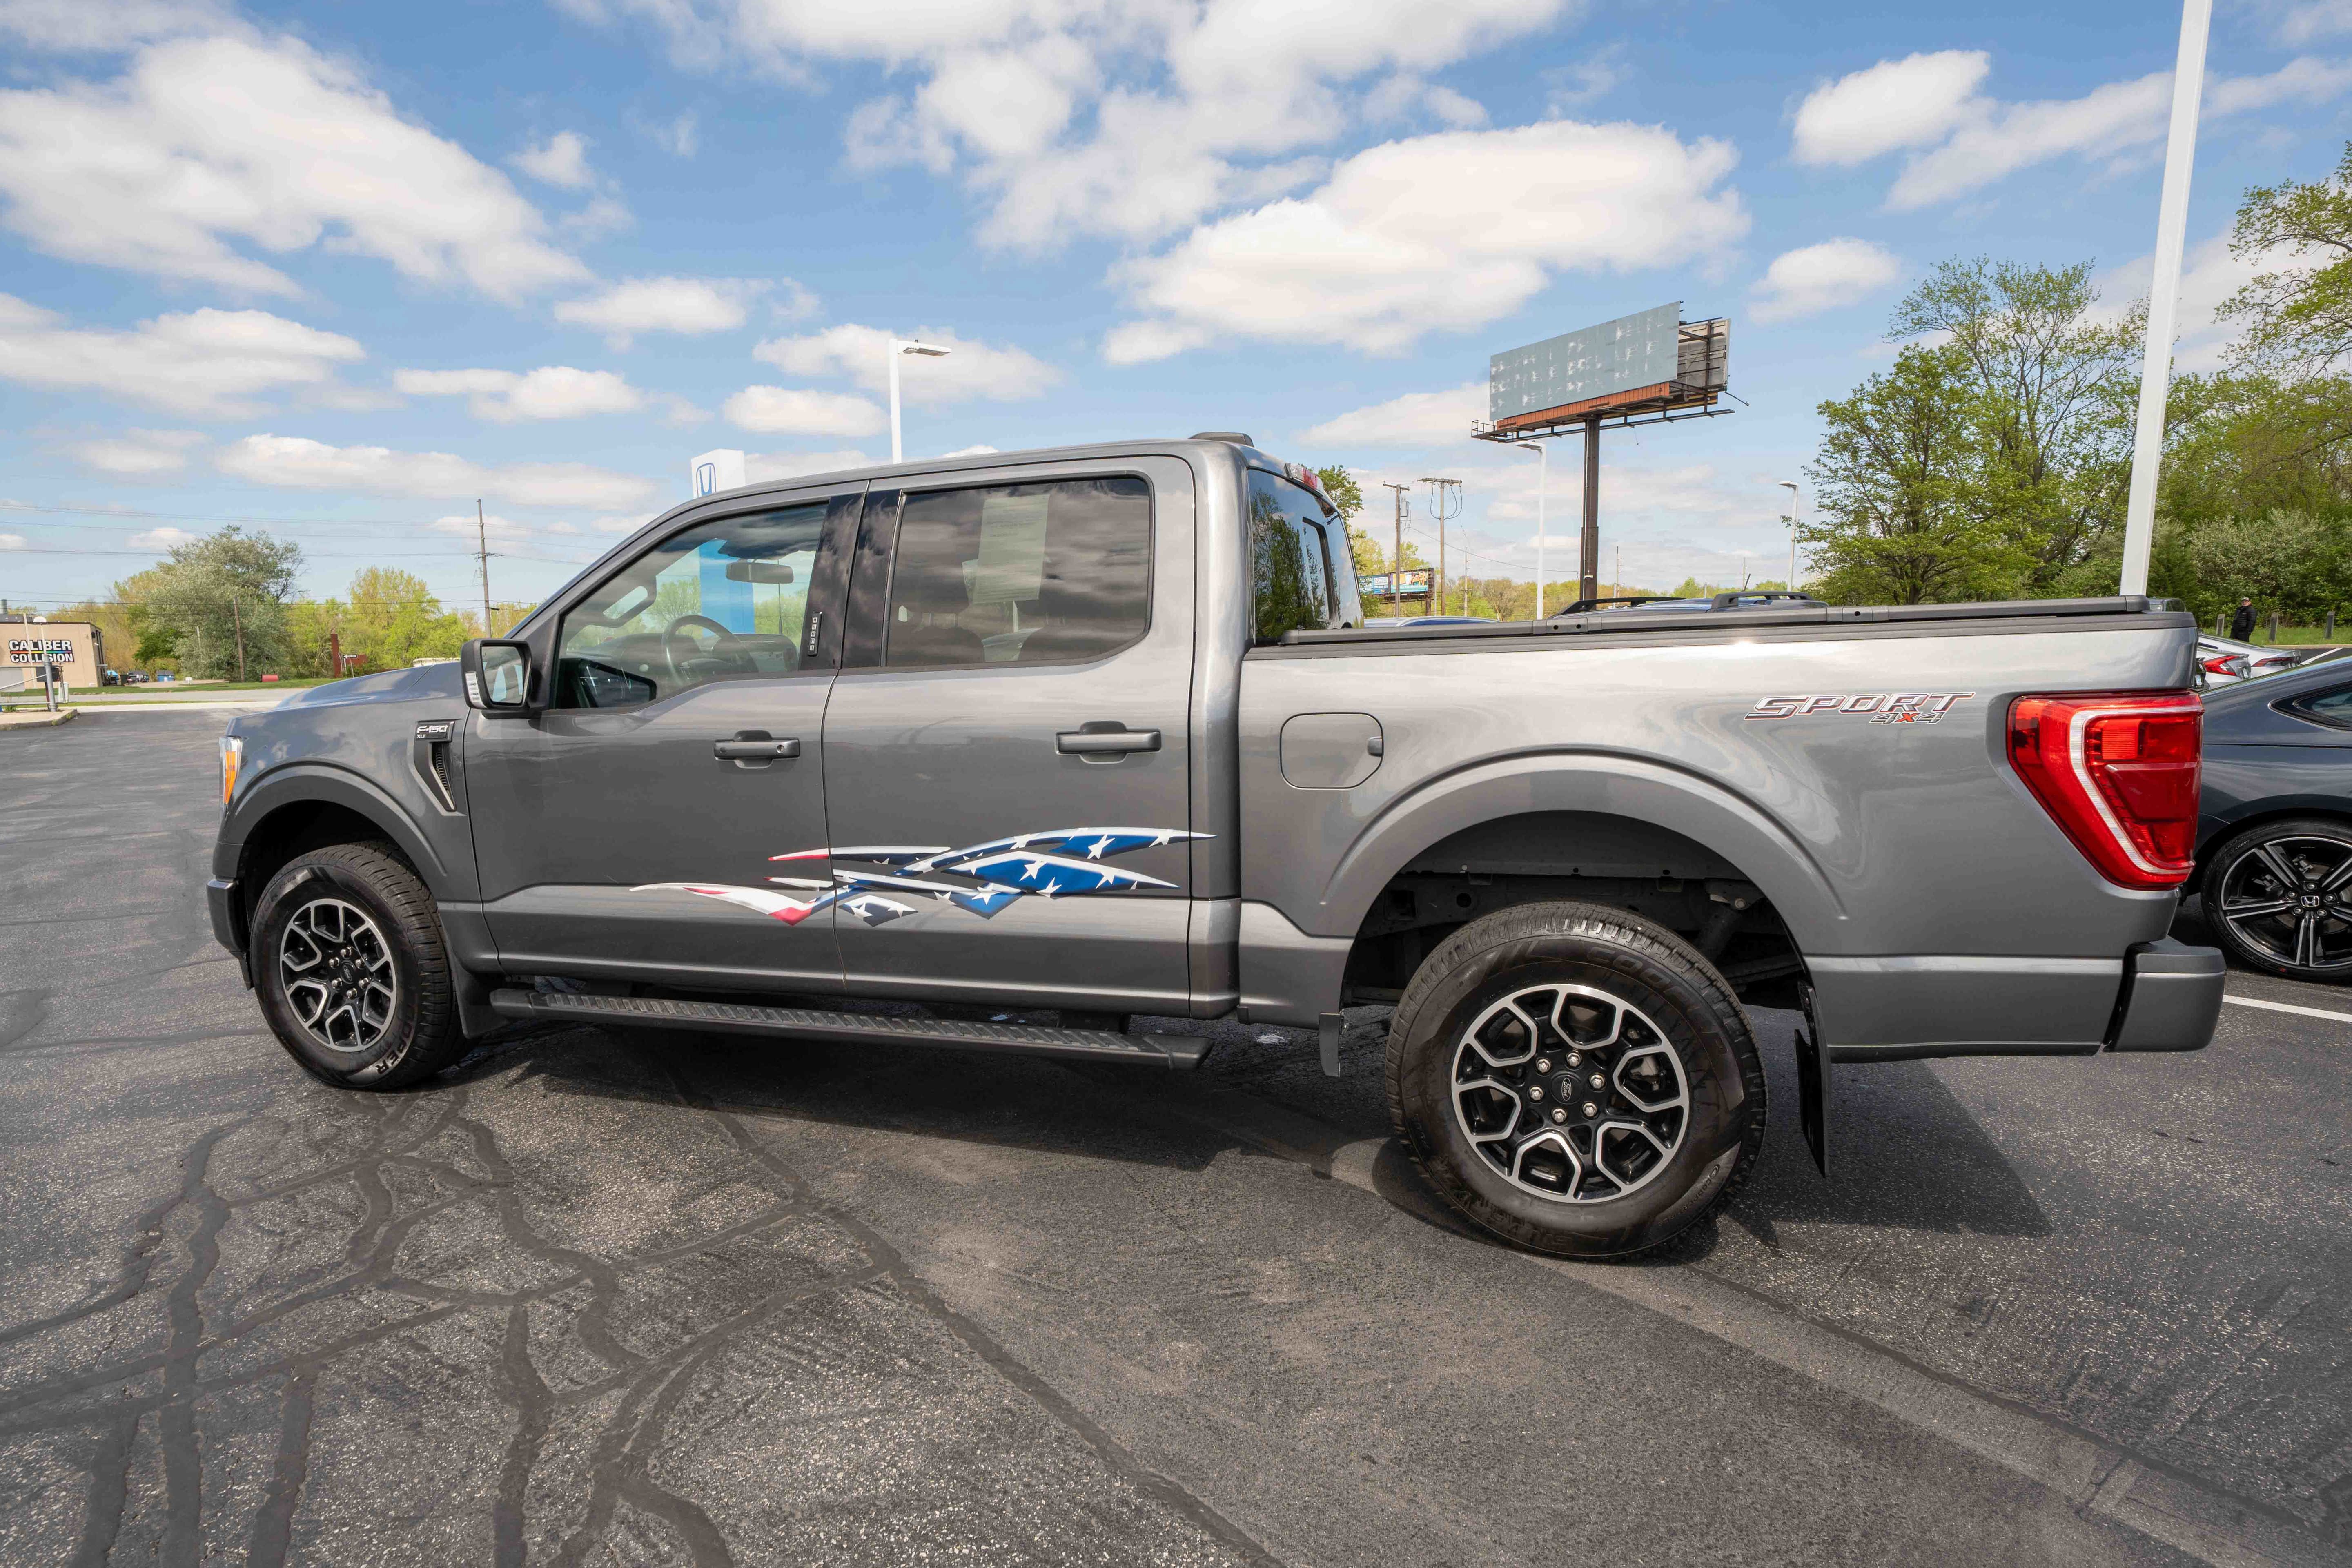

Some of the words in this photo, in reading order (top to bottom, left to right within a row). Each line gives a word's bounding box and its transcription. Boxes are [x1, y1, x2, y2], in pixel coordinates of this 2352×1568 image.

[9, 640, 71, 651] CALIBER
[11, 653, 74, 662] COLLSION
[1744, 693, 1976, 720] SPORT
[1563, 1081, 1571, 1098] Ford
